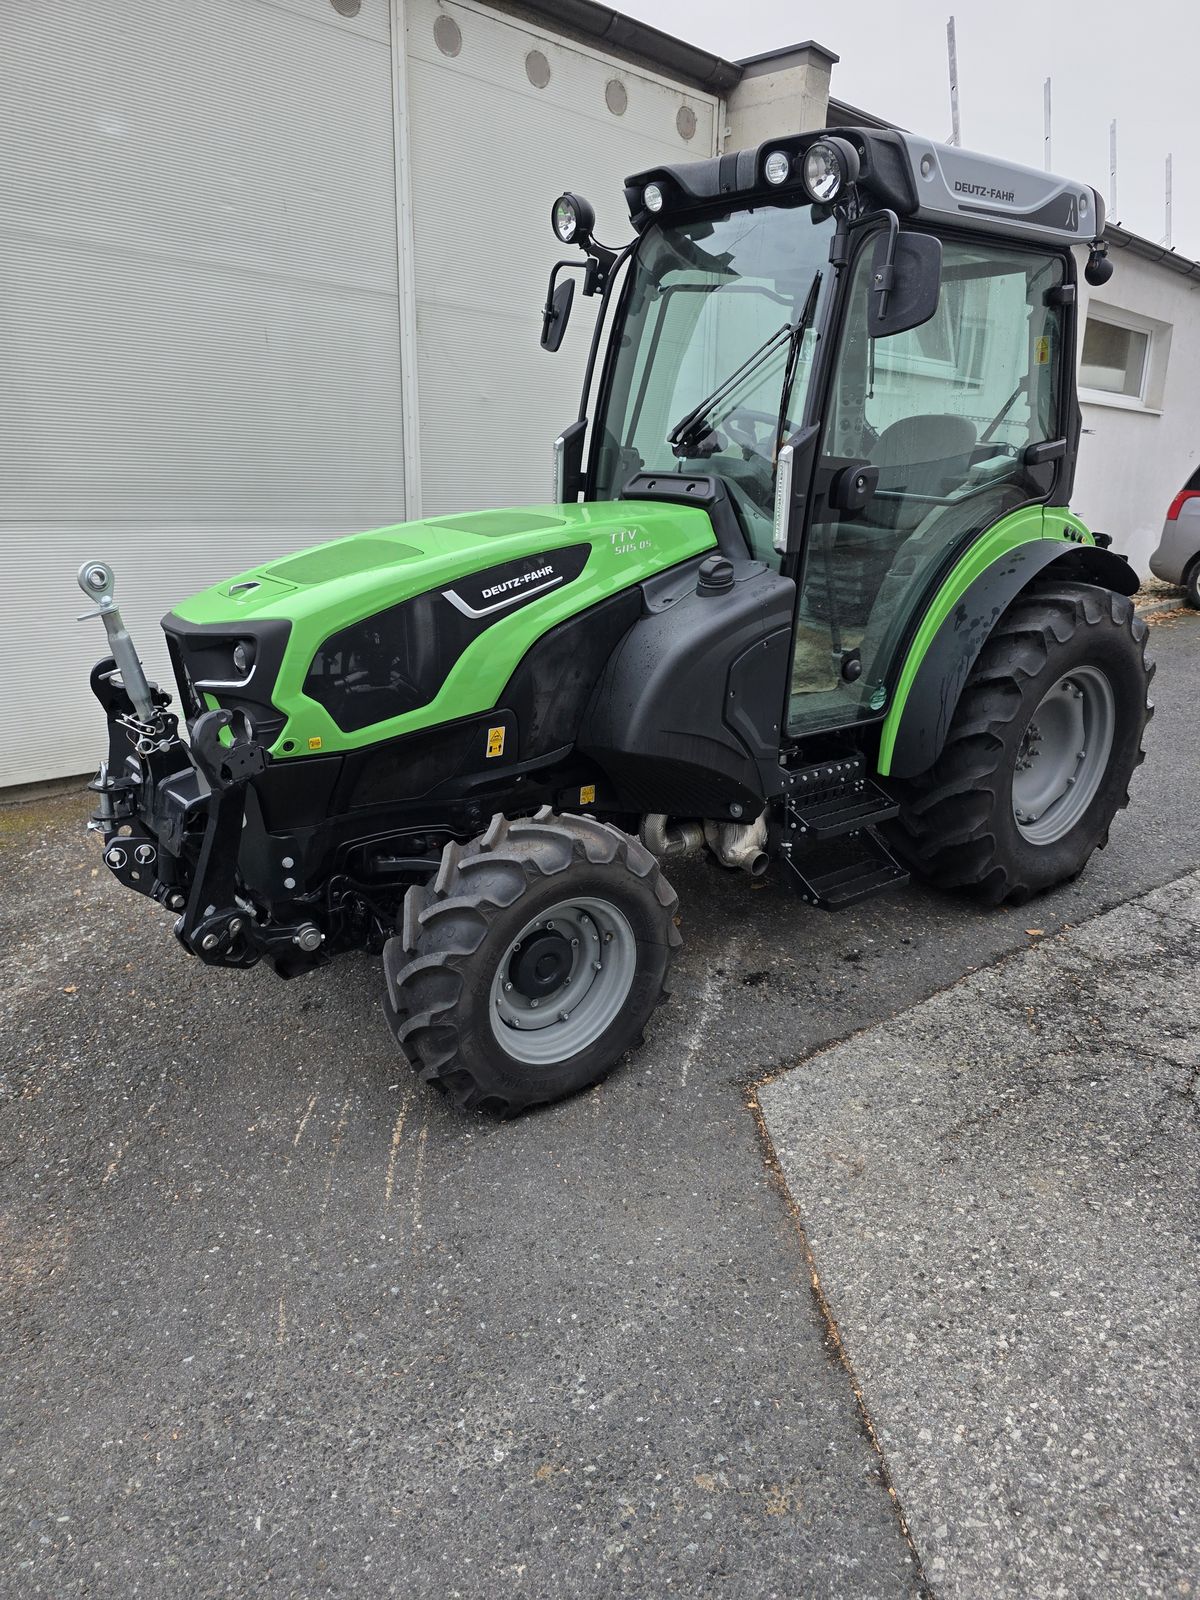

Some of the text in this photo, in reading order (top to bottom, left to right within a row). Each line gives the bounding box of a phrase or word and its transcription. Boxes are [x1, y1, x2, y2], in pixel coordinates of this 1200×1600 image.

[954, 181, 1015, 203] DEUTZ-FAHR
[609, 529, 637, 545] TTV
[481, 565, 554, 599] DEUTZ-FAHR
